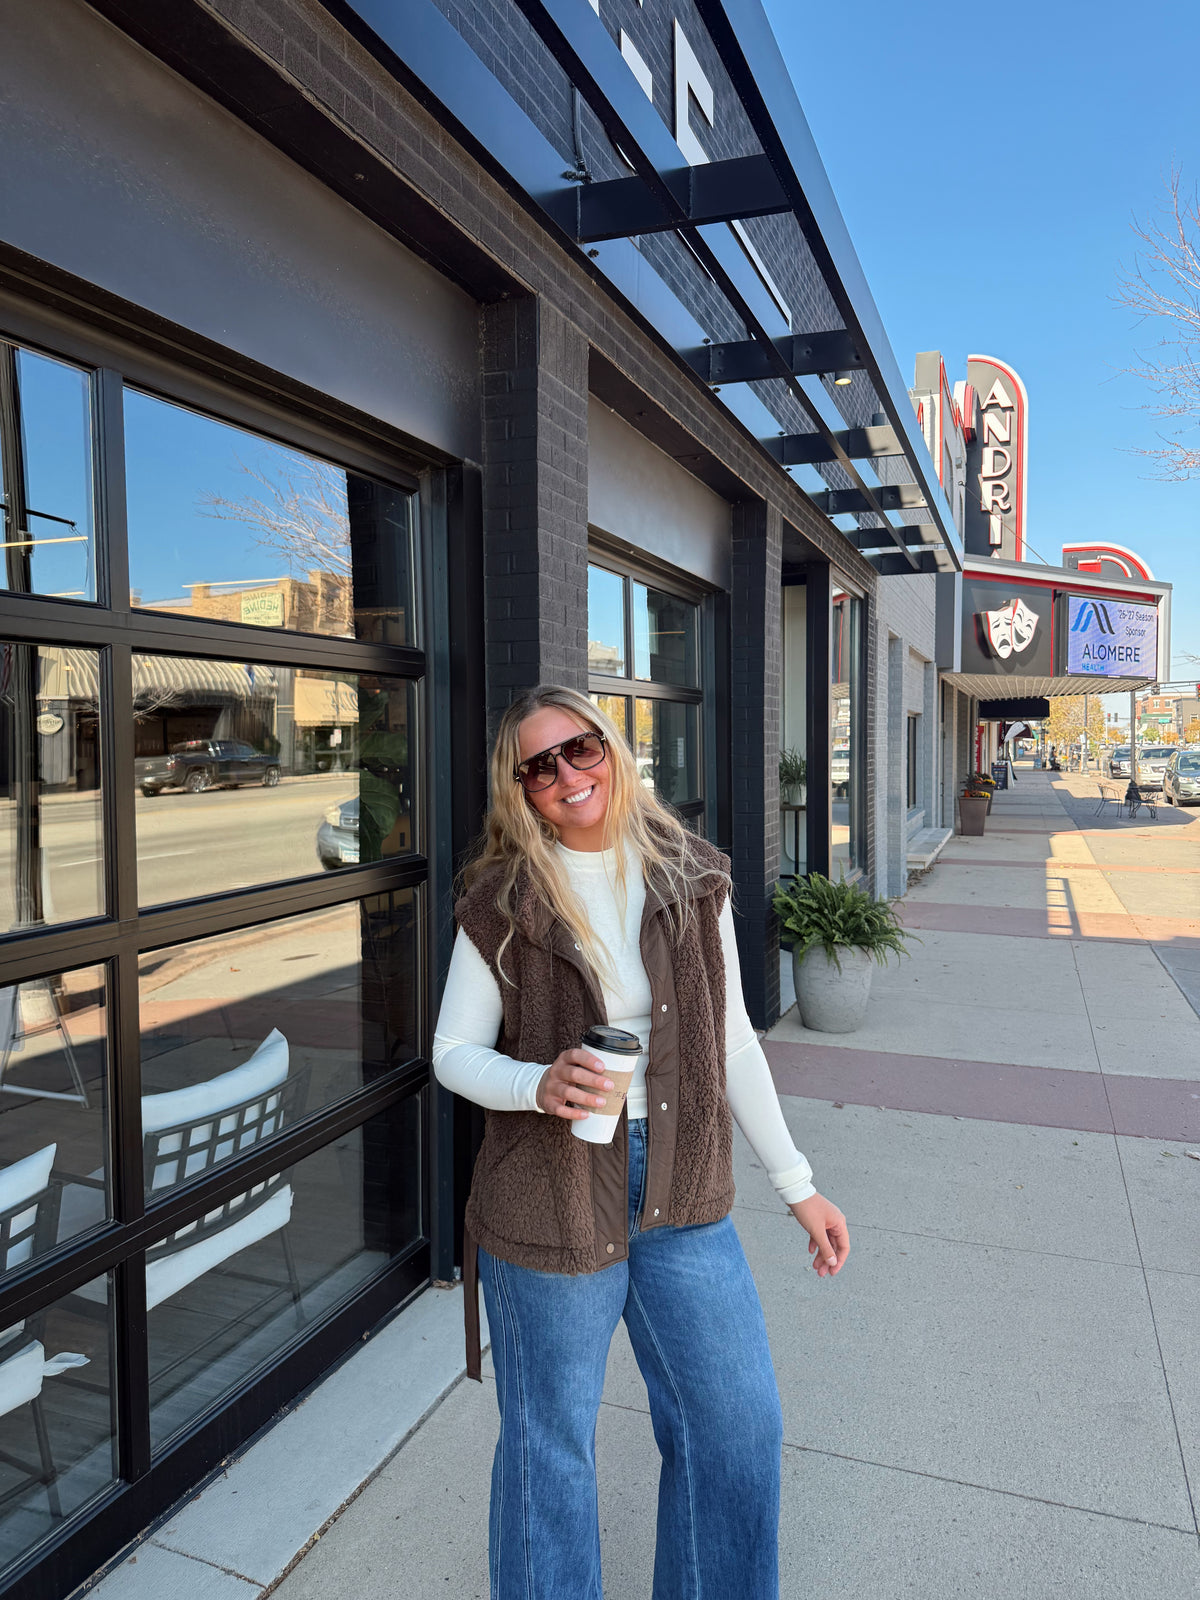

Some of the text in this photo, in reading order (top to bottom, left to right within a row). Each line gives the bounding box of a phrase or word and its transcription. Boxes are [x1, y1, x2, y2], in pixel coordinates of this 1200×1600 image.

[980, 377, 1014, 558] ANDRI
[1125, 626, 1146, 637] Sponsor
[1082, 643, 1140, 663] ALOMERE
[1081, 662, 1105, 671] HEALTH
